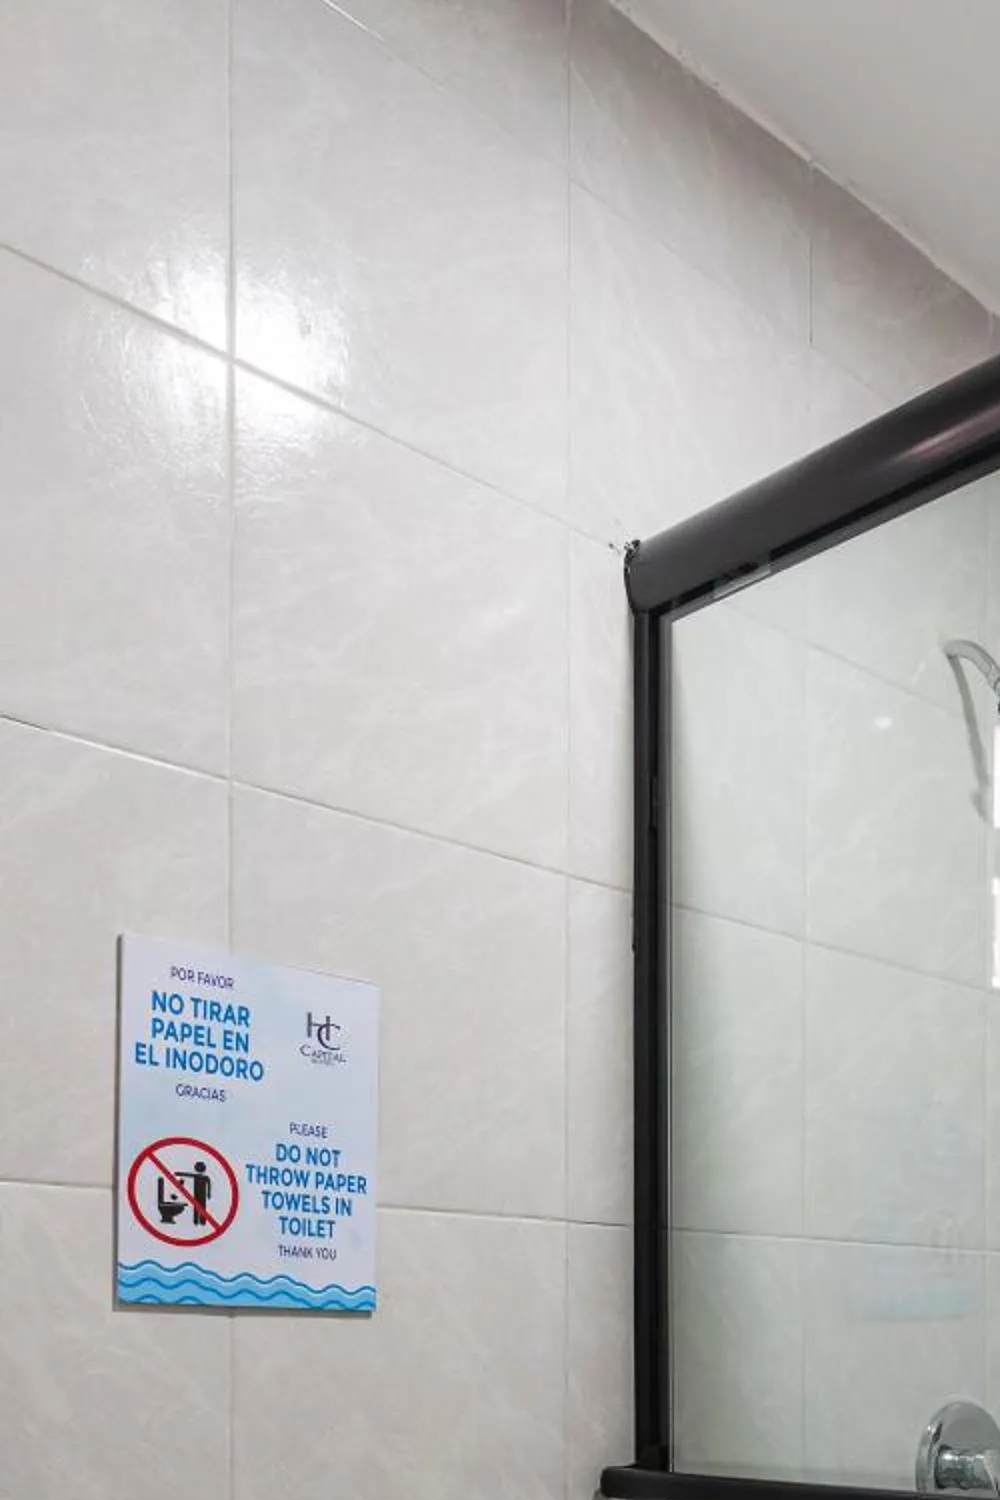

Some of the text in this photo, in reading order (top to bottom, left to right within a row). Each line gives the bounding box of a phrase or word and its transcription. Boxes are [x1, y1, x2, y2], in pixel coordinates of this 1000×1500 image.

[171, 966, 234, 989] POR FAVOR
[151, 990, 250, 1028] NO TIRAR
[151, 1017, 249, 1053] PAPEL EN
[135, 1041, 264, 1081] EL INODORO
[175, 1083, 226, 1102] GRACIAS
[289, 1121, 328, 1139] PLEASE
[275, 1143, 341, 1168] DO NOT
[245, 1163, 367, 1194] THROW PAPER
[261, 1189, 352, 1217] TOWELS IN
[278, 1215, 336, 1239] TOILET
[278, 1243, 337, 1261] THANK YOU
